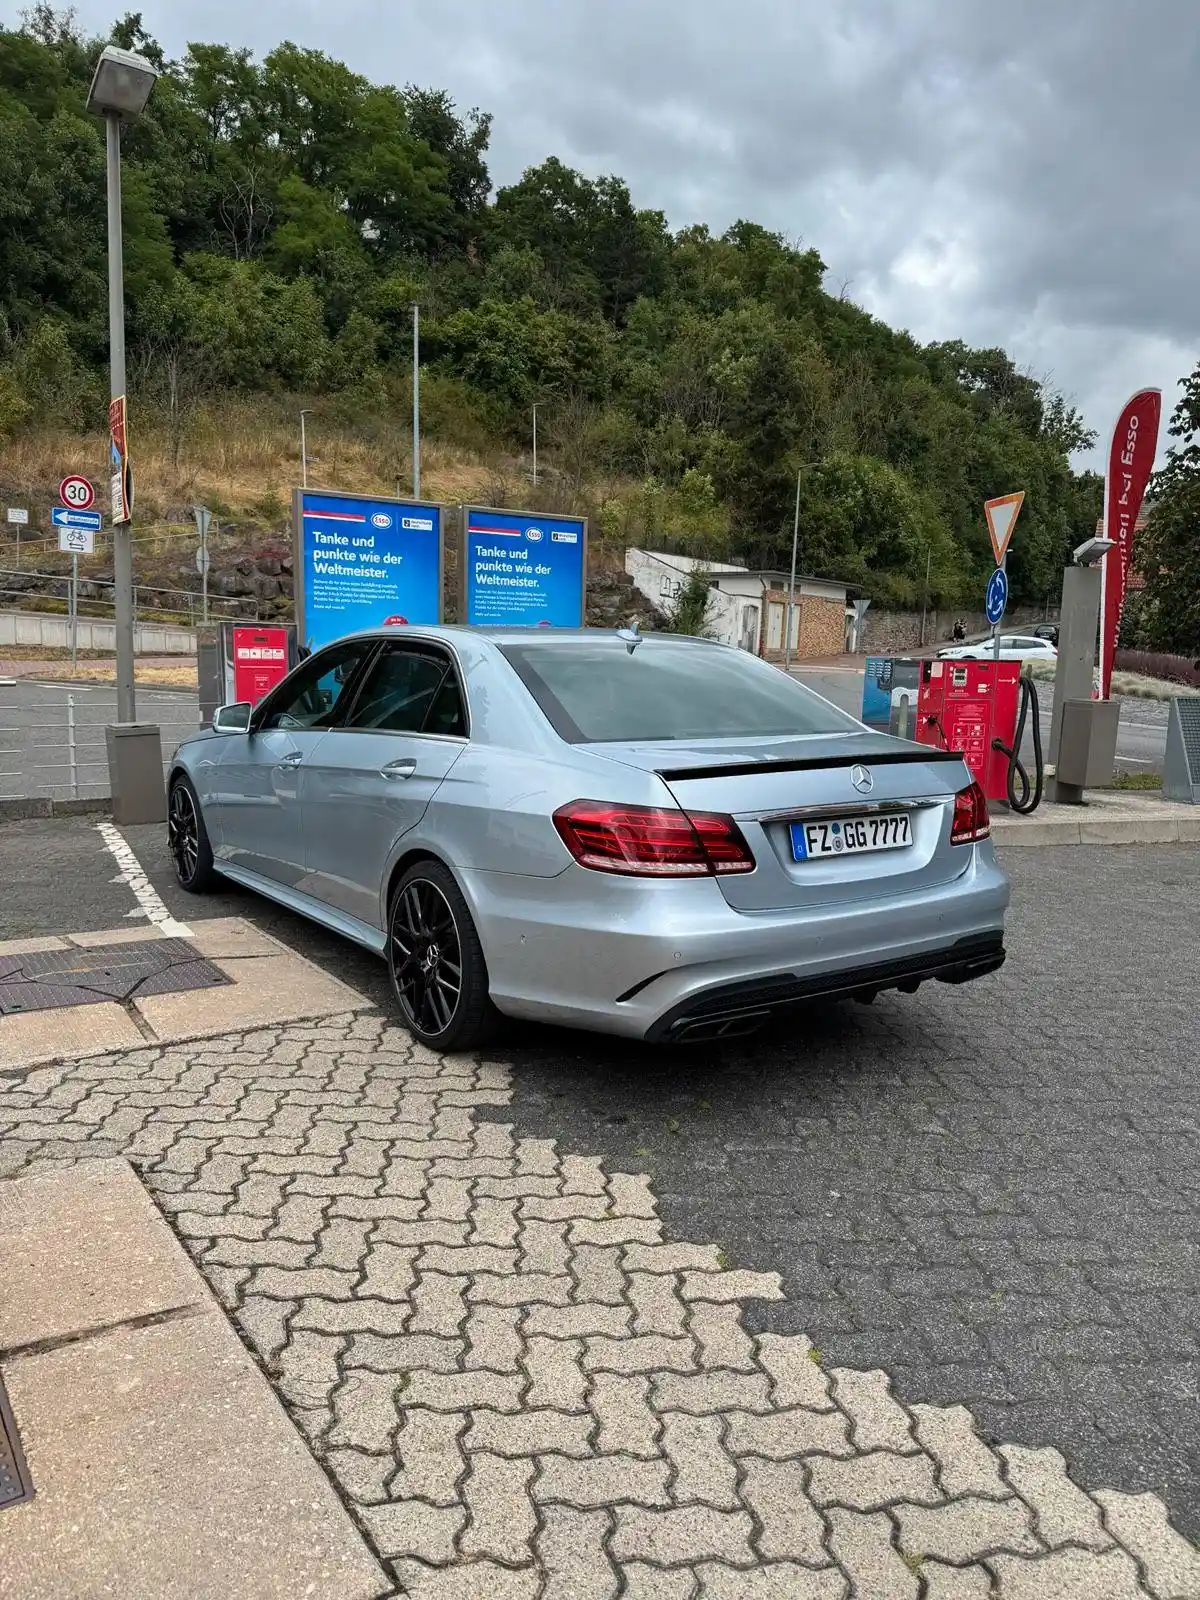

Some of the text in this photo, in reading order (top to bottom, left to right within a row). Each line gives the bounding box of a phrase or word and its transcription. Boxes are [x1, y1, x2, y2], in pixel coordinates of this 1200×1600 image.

[1120, 415, 1139, 466] Esso
[67, 485, 88, 501] 30
[312, 531, 375, 548] Tanke und
[313, 548, 403, 565] punkte wie der
[475, 545, 528, 560] Tanke und
[313, 562, 389, 579] Weltmeister.
[475, 560, 552, 575] punkte wie der
[475, 573, 540, 588] Weltmeister.
[806, 816, 909, 853] FZ GG 7777
[797, 844, 803, 853] D
